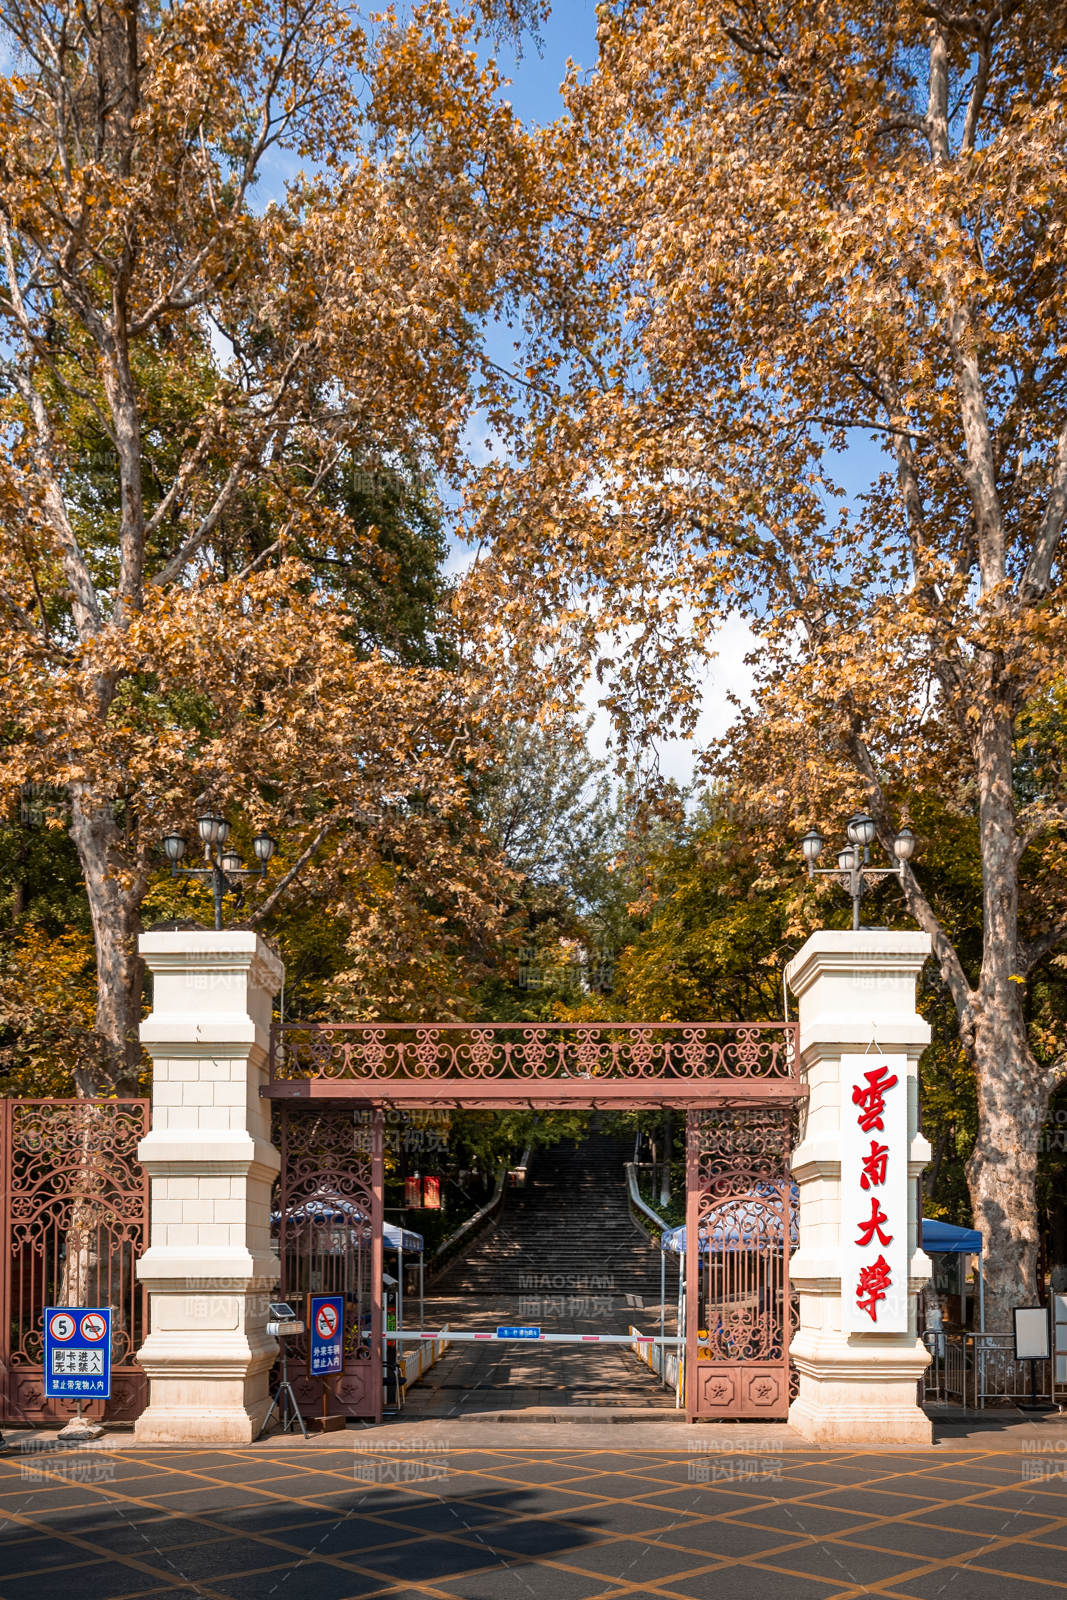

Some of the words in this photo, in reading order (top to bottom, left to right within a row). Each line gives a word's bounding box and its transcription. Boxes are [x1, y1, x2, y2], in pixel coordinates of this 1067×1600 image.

[852, 1066, 898, 1322] 雲南大學
[58, 1320, 67, 1336] 5
[55, 1351, 100, 1362] 刷卡进入
[55, 1362, 100, 1373] 无卡禁入
[313, 1357, 340, 1369] 禁止入内
